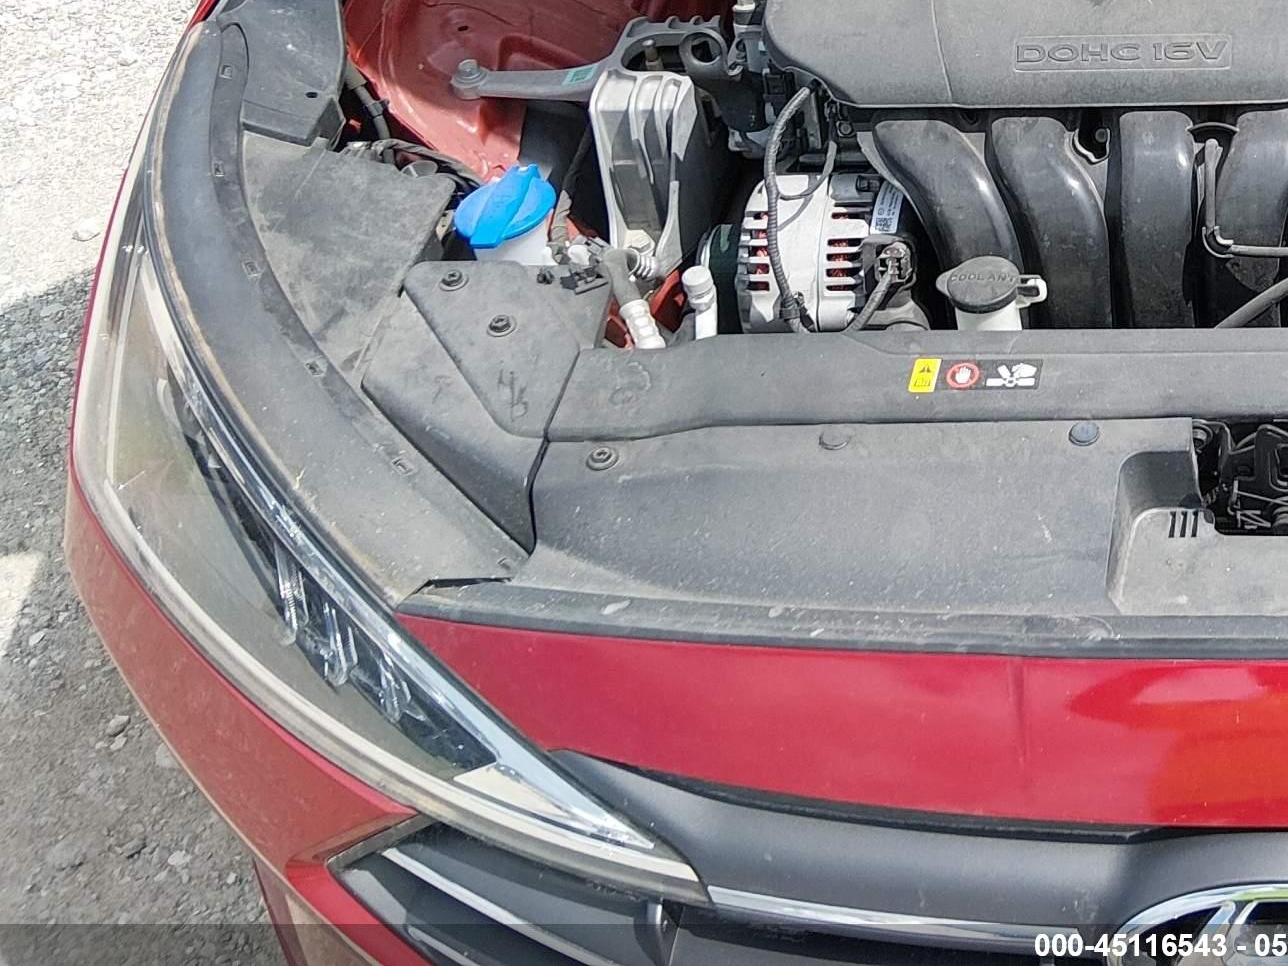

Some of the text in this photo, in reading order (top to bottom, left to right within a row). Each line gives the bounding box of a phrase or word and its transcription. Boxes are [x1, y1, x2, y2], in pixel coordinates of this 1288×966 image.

[1016, 40, 1228, 63] DOHC 16V
[949, 273, 1016, 283] COOLANT
